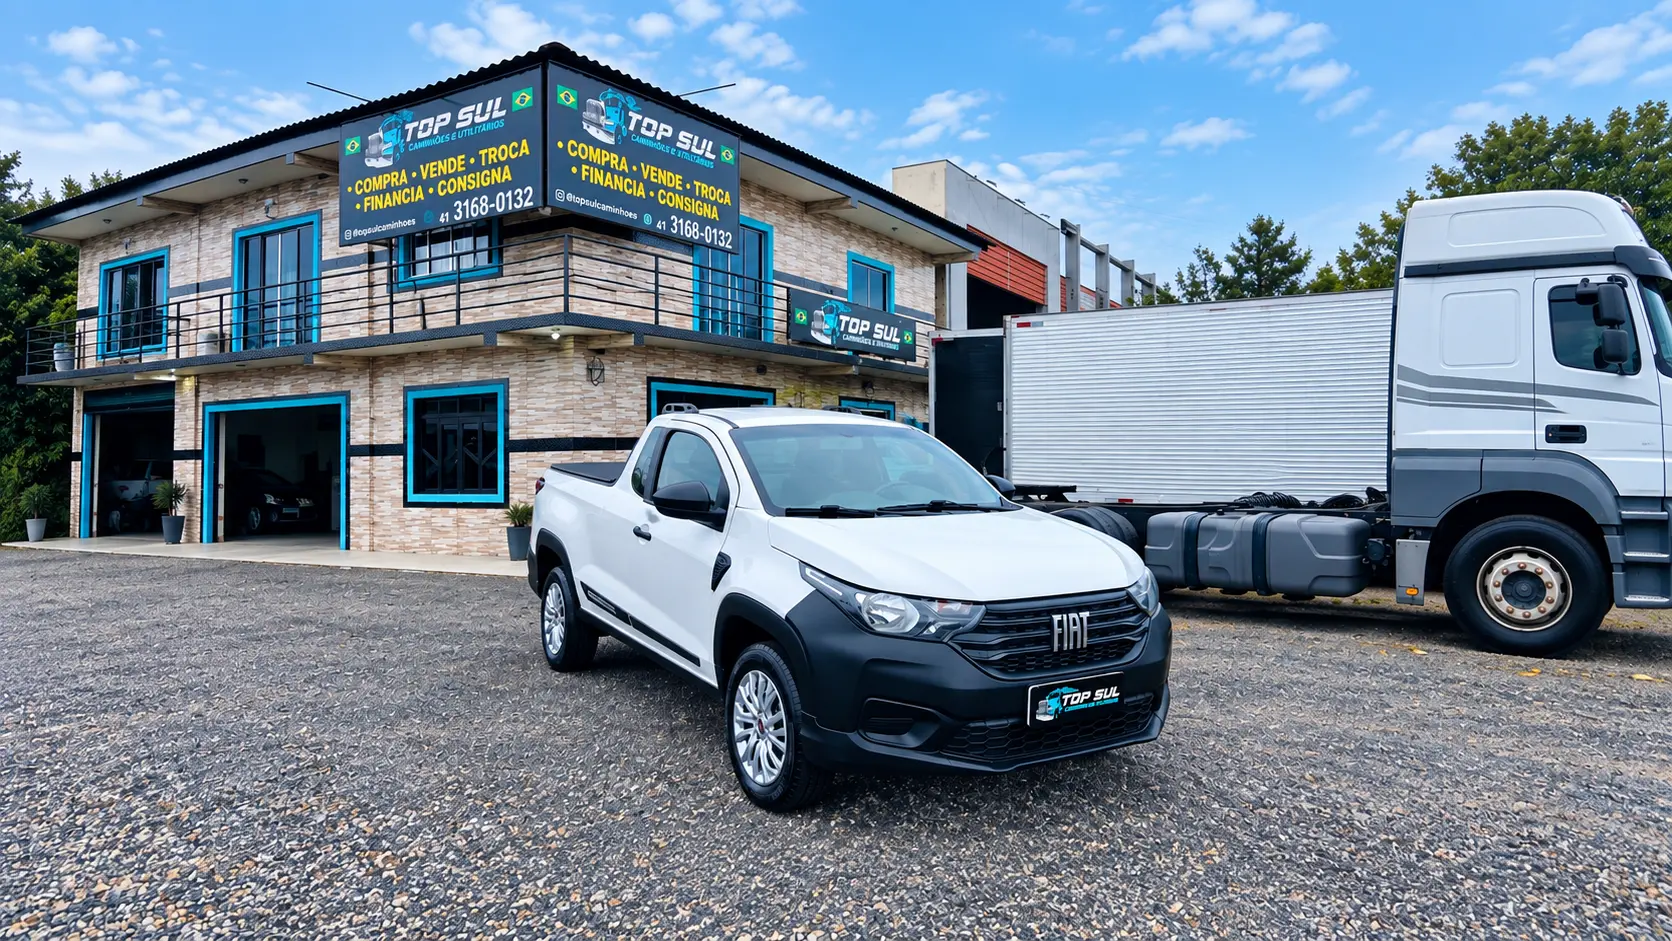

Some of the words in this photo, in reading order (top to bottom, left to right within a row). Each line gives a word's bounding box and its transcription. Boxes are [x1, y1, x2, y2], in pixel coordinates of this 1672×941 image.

[405, 112, 451, 142] TOP
[455, 97, 507, 129] SUL
[628, 110, 673, 141] TOP
[675, 130, 717, 160] SUL
[355, 168, 407, 195] COMPRA
[420, 154, 466, 180] VENDE
[478, 138, 530, 167] TROCA
[567, 139, 629, 173] COMPRA
[640, 162, 683, 191] VENDE
[693, 180, 732, 206] TROCA
[363, 185, 424, 212] FINANCIA
[437, 165, 512, 196] CONSIGNA
[439, 211, 449, 224] 41
[453, 186, 534, 221] 3168-0132
[566, 192, 638, 220] @topsulcaminhoes
[581, 165, 646, 199] FINANCIA
[657, 189, 719, 221] CONSIGNA
[656, 220, 666, 231] 41
[670, 215, 733, 249] 3168-0132
[839, 315, 870, 335] TOP
[873, 323, 901, 343] SUL
[1052, 611, 1090, 652] FIAT
[1062, 690, 1092, 707] TOP
[1093, 686, 1121, 701] SUL
